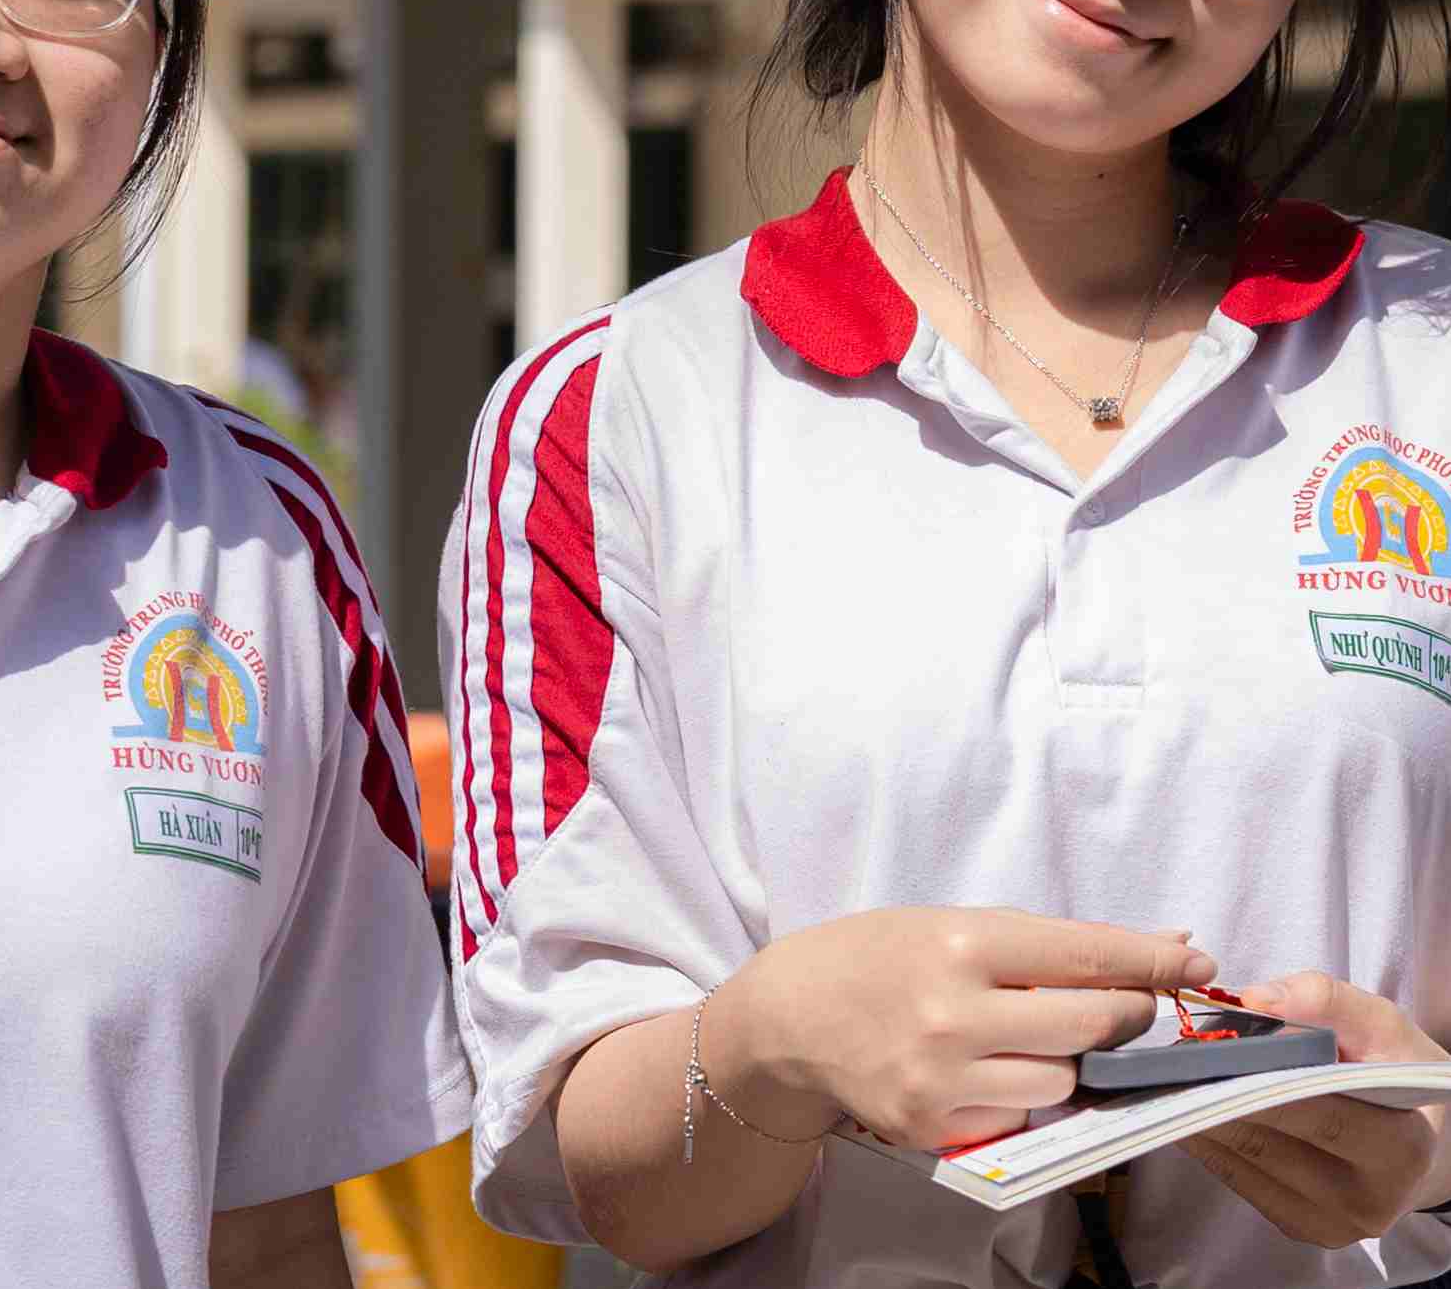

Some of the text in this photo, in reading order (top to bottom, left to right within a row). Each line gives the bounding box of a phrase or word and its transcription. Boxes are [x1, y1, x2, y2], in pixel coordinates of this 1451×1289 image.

[1293, 466, 1327, 533] TRƯỜNG
[1323, 423, 1381, 465] TRUNG
[1383, 429, 1415, 459] HỌC
[1297, 567, 1386, 591] HÙNG
[101, 629, 135, 702] TRƯỜNG
[129, 590, 186, 633] TRUNG
[1330, 630, 1370, 659] NHƯ
[1372, 632, 1423, 674] QUỲNH
[111, 742, 264, 788] HÙNG VƯƠN
[158, 804, 182, 839] HÀ
[185, 811, 222, 846] XUÂN
